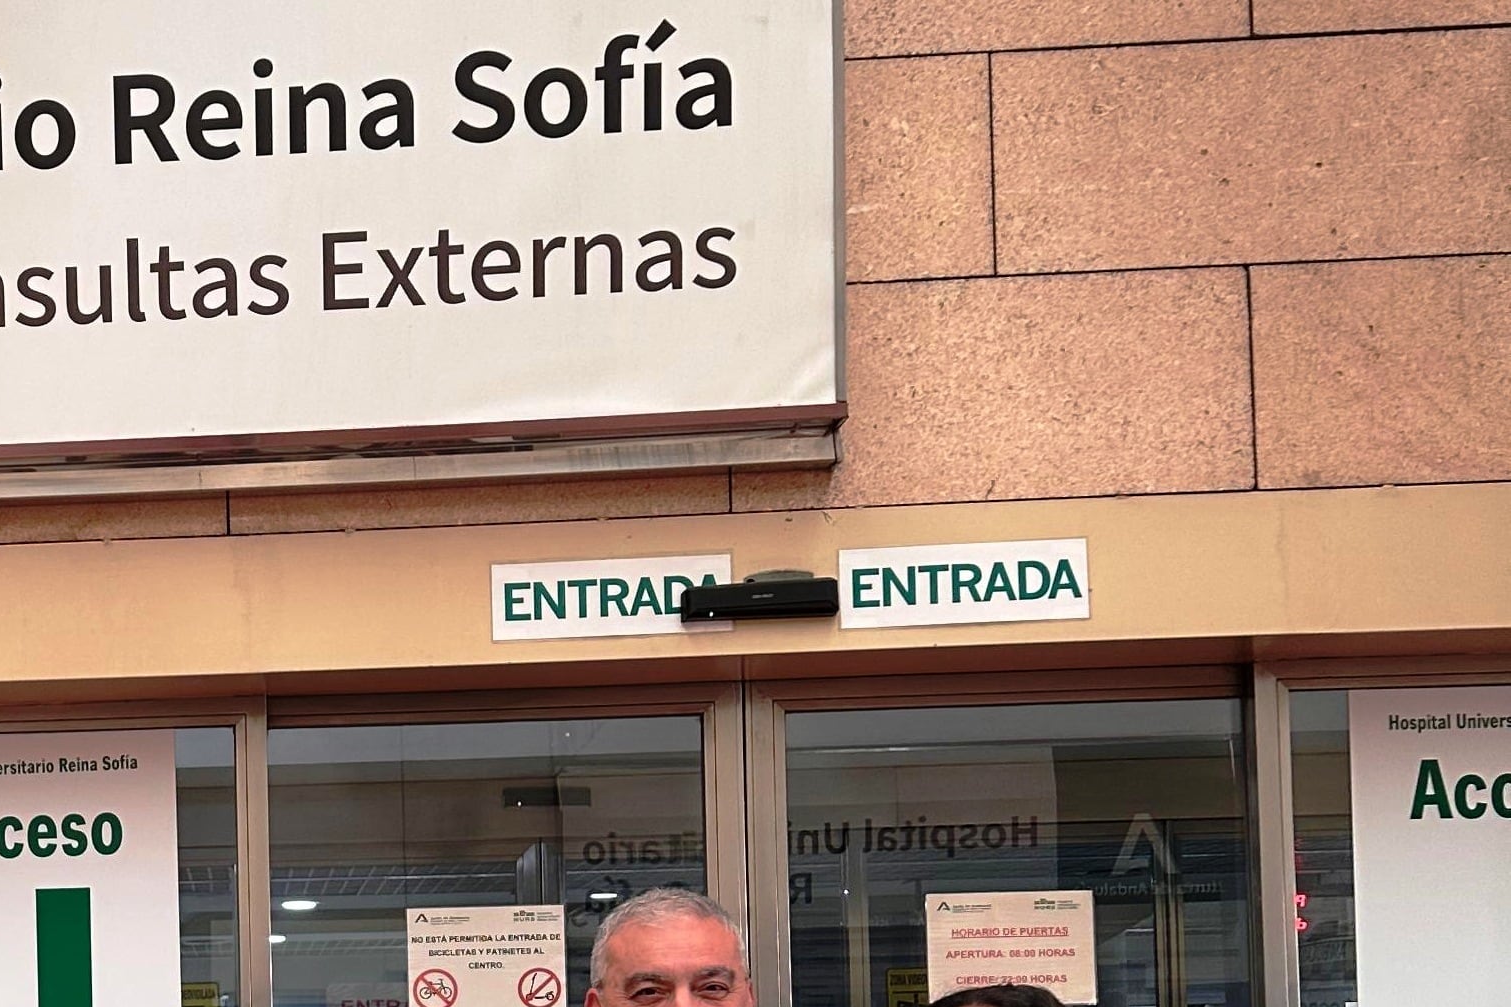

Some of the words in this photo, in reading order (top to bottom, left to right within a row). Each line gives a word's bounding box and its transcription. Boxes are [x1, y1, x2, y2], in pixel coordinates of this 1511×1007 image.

[112, 58, 415, 165] Reina
[451, 19, 734, 145] Sofía
[321, 225, 738, 311] Externas
[851, 559, 1082, 608] ENTRADA
[504, 573, 717, 622] ENTRAD
[1389, 713, 1452, 731] Hospital
[58, 756, 99, 774] Reina
[102, 754, 138, 772] Sofía
[411, 936, 424, 944] NO
[449, 935, 493, 943] PERMITIDA
[495, 934, 506, 942] LA
[508, 934, 547, 942] ENTRADA
[549, 933, 561, 941] DE
[951, 927, 1000, 937] HORARIO
[1003, 927, 1017, 936] DE
[1019, 926, 1069, 936] PUERTAS
[428, 948, 477, 956] BICICLETAS
[533, 947, 545, 955] AL
[1038, 948, 1076, 957] HORAS
[1030, 974, 1068, 984] HORAS
